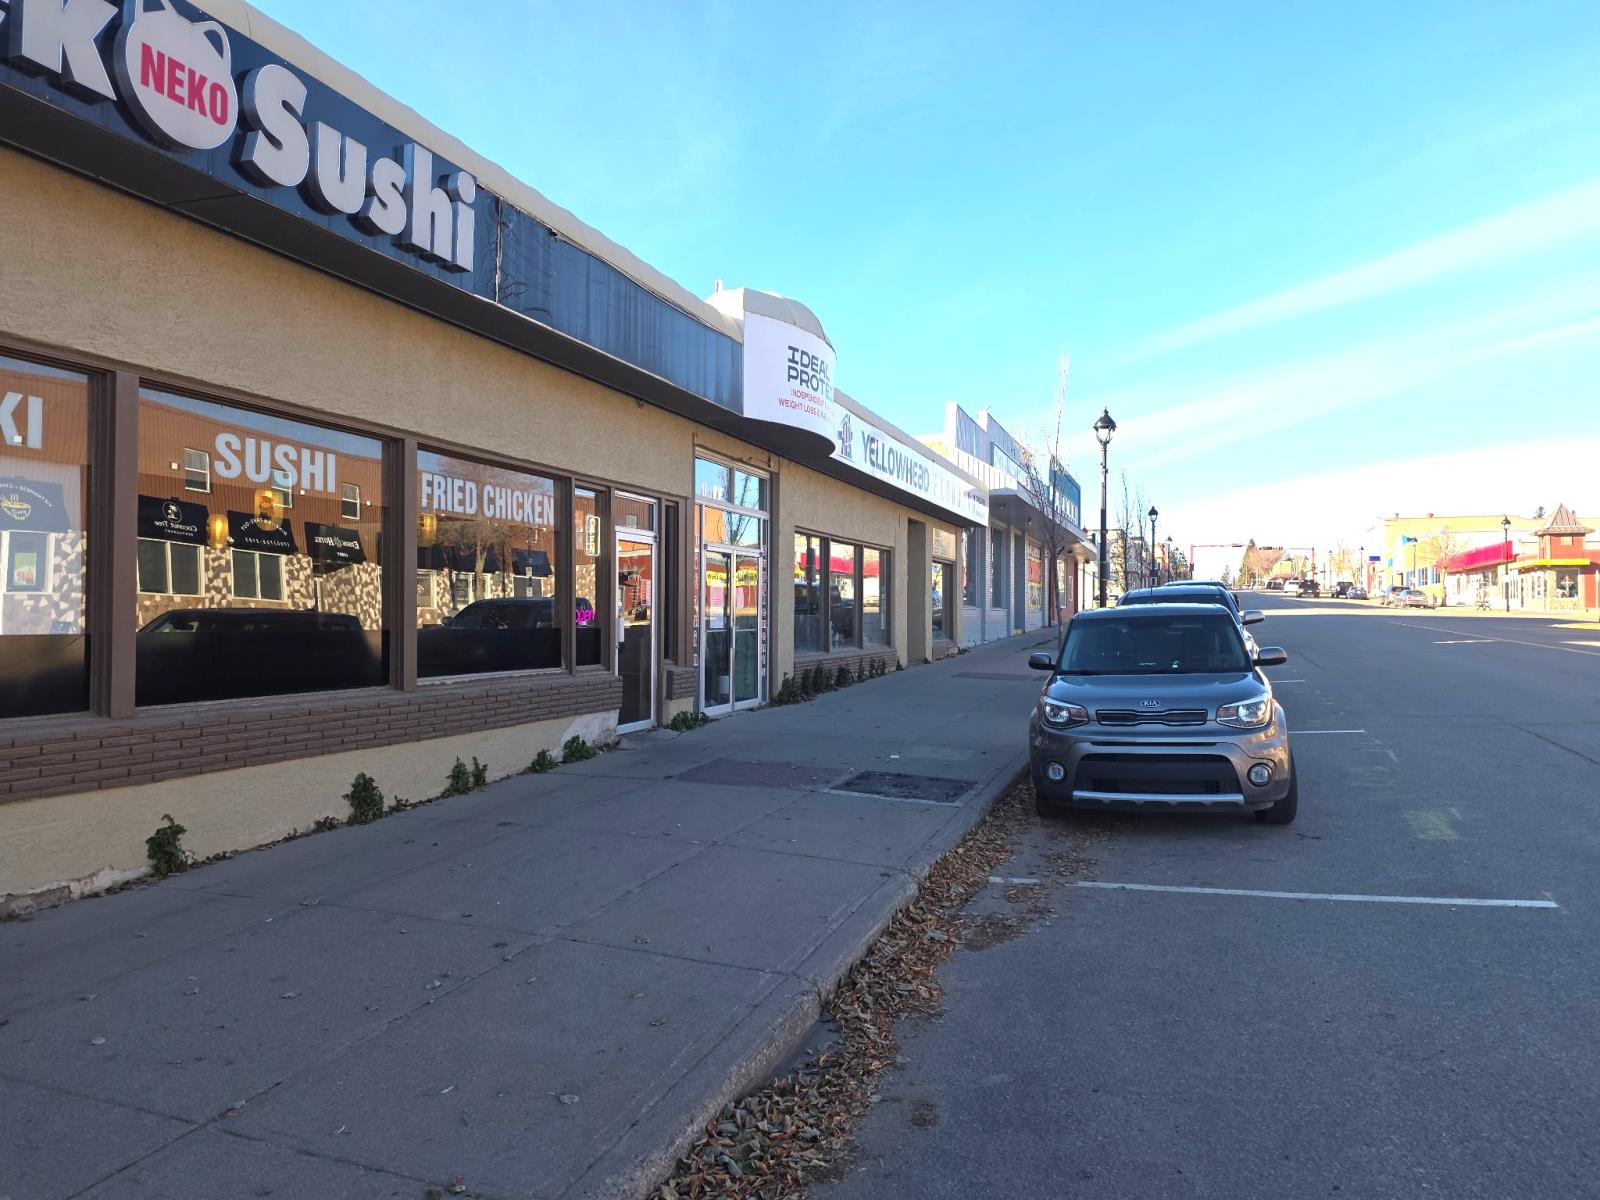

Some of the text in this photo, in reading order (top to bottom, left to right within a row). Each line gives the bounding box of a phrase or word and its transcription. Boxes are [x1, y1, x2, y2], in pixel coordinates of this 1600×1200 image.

[140, 42, 229, 126] NEKO
[252, 64, 476, 273] Sushi
[788, 345, 830, 382] IDEAL
[779, 397, 803, 412] WEIGHT
[214, 433, 336, 493] SUSHI
[421, 471, 554, 526] FRIED CHICKEN
